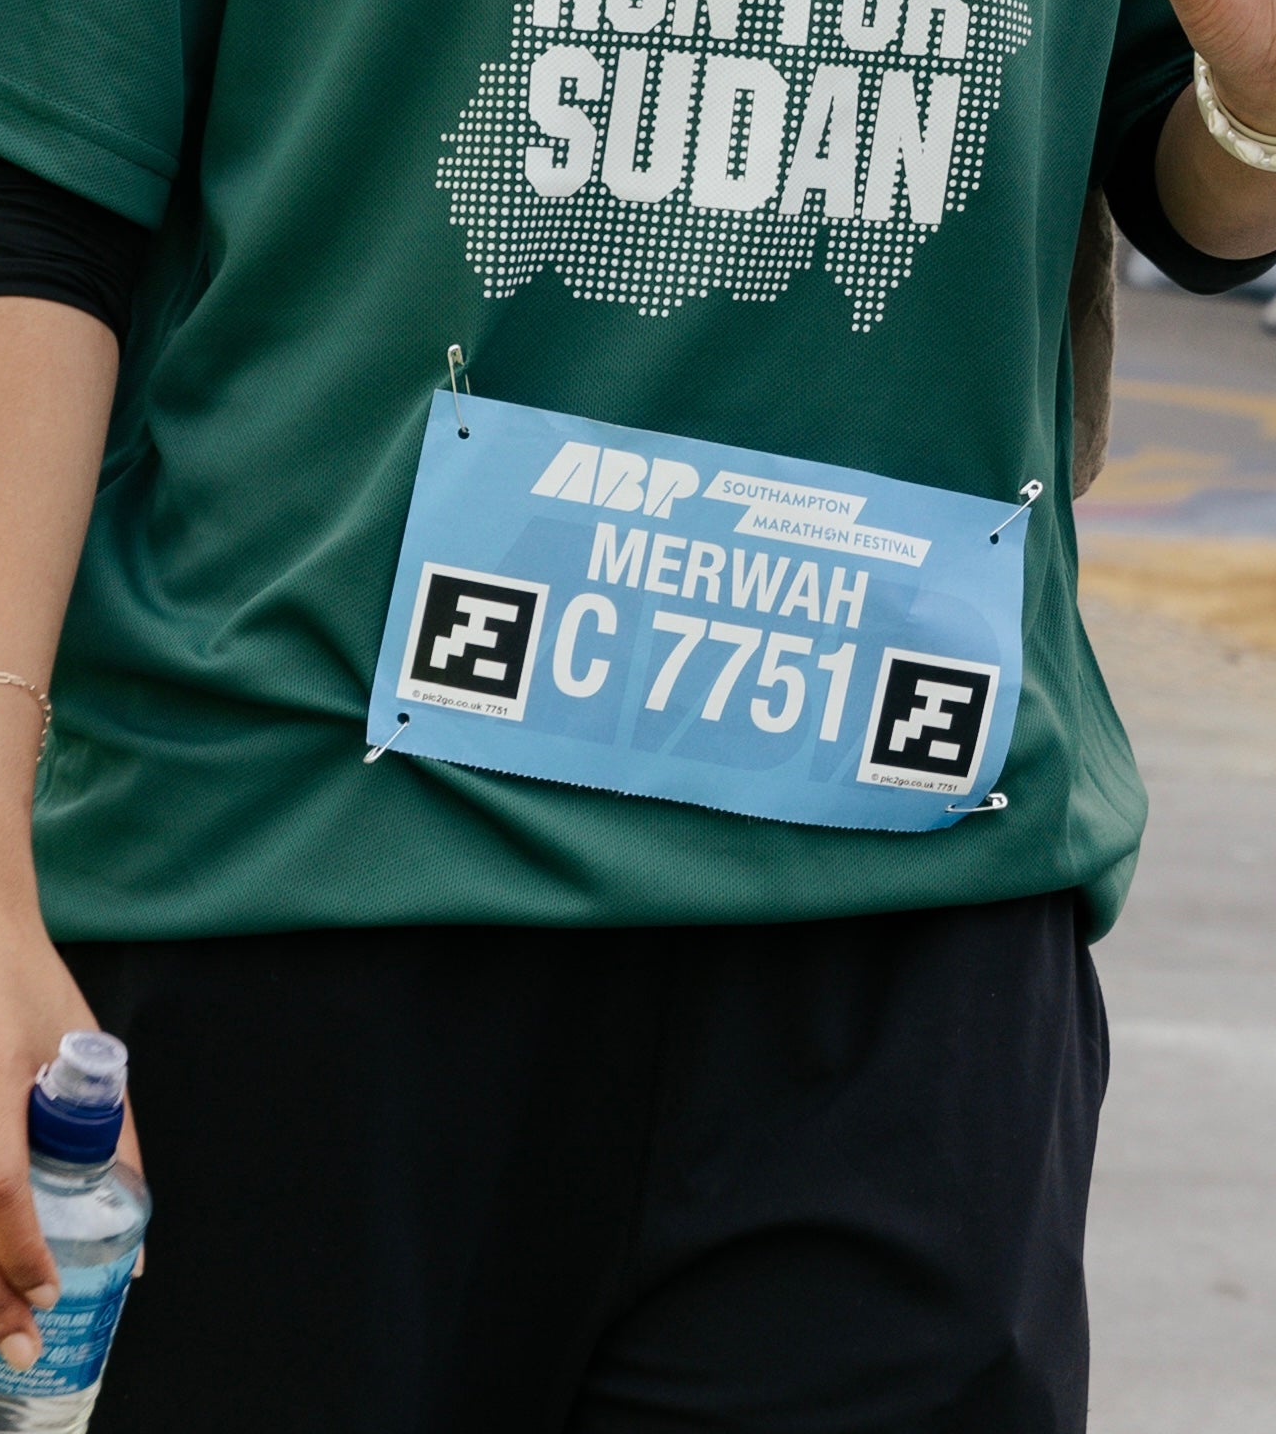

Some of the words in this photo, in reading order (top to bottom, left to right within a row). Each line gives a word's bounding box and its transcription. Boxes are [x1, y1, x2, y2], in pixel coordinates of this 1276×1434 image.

[524, 43, 963, 226] SUDAN
[530, 441, 700, 519] ABP
[722, 479, 851, 515] SOUTHAMPTON
[586, 522, 869, 629] MERWAH
[752, 514, 850, 545] MARATHON
[853, 532, 917, 559] FESTIVAL
[421, 692, 482, 711] pic2go.co.uk
[485, 704, 508, 716] 7751
[551, 593, 618, 698] C
[645, 611, 858, 742] 7751
[880, 776, 935, 790] pic2go.co.uk
[937, 782, 957, 792] 7751
